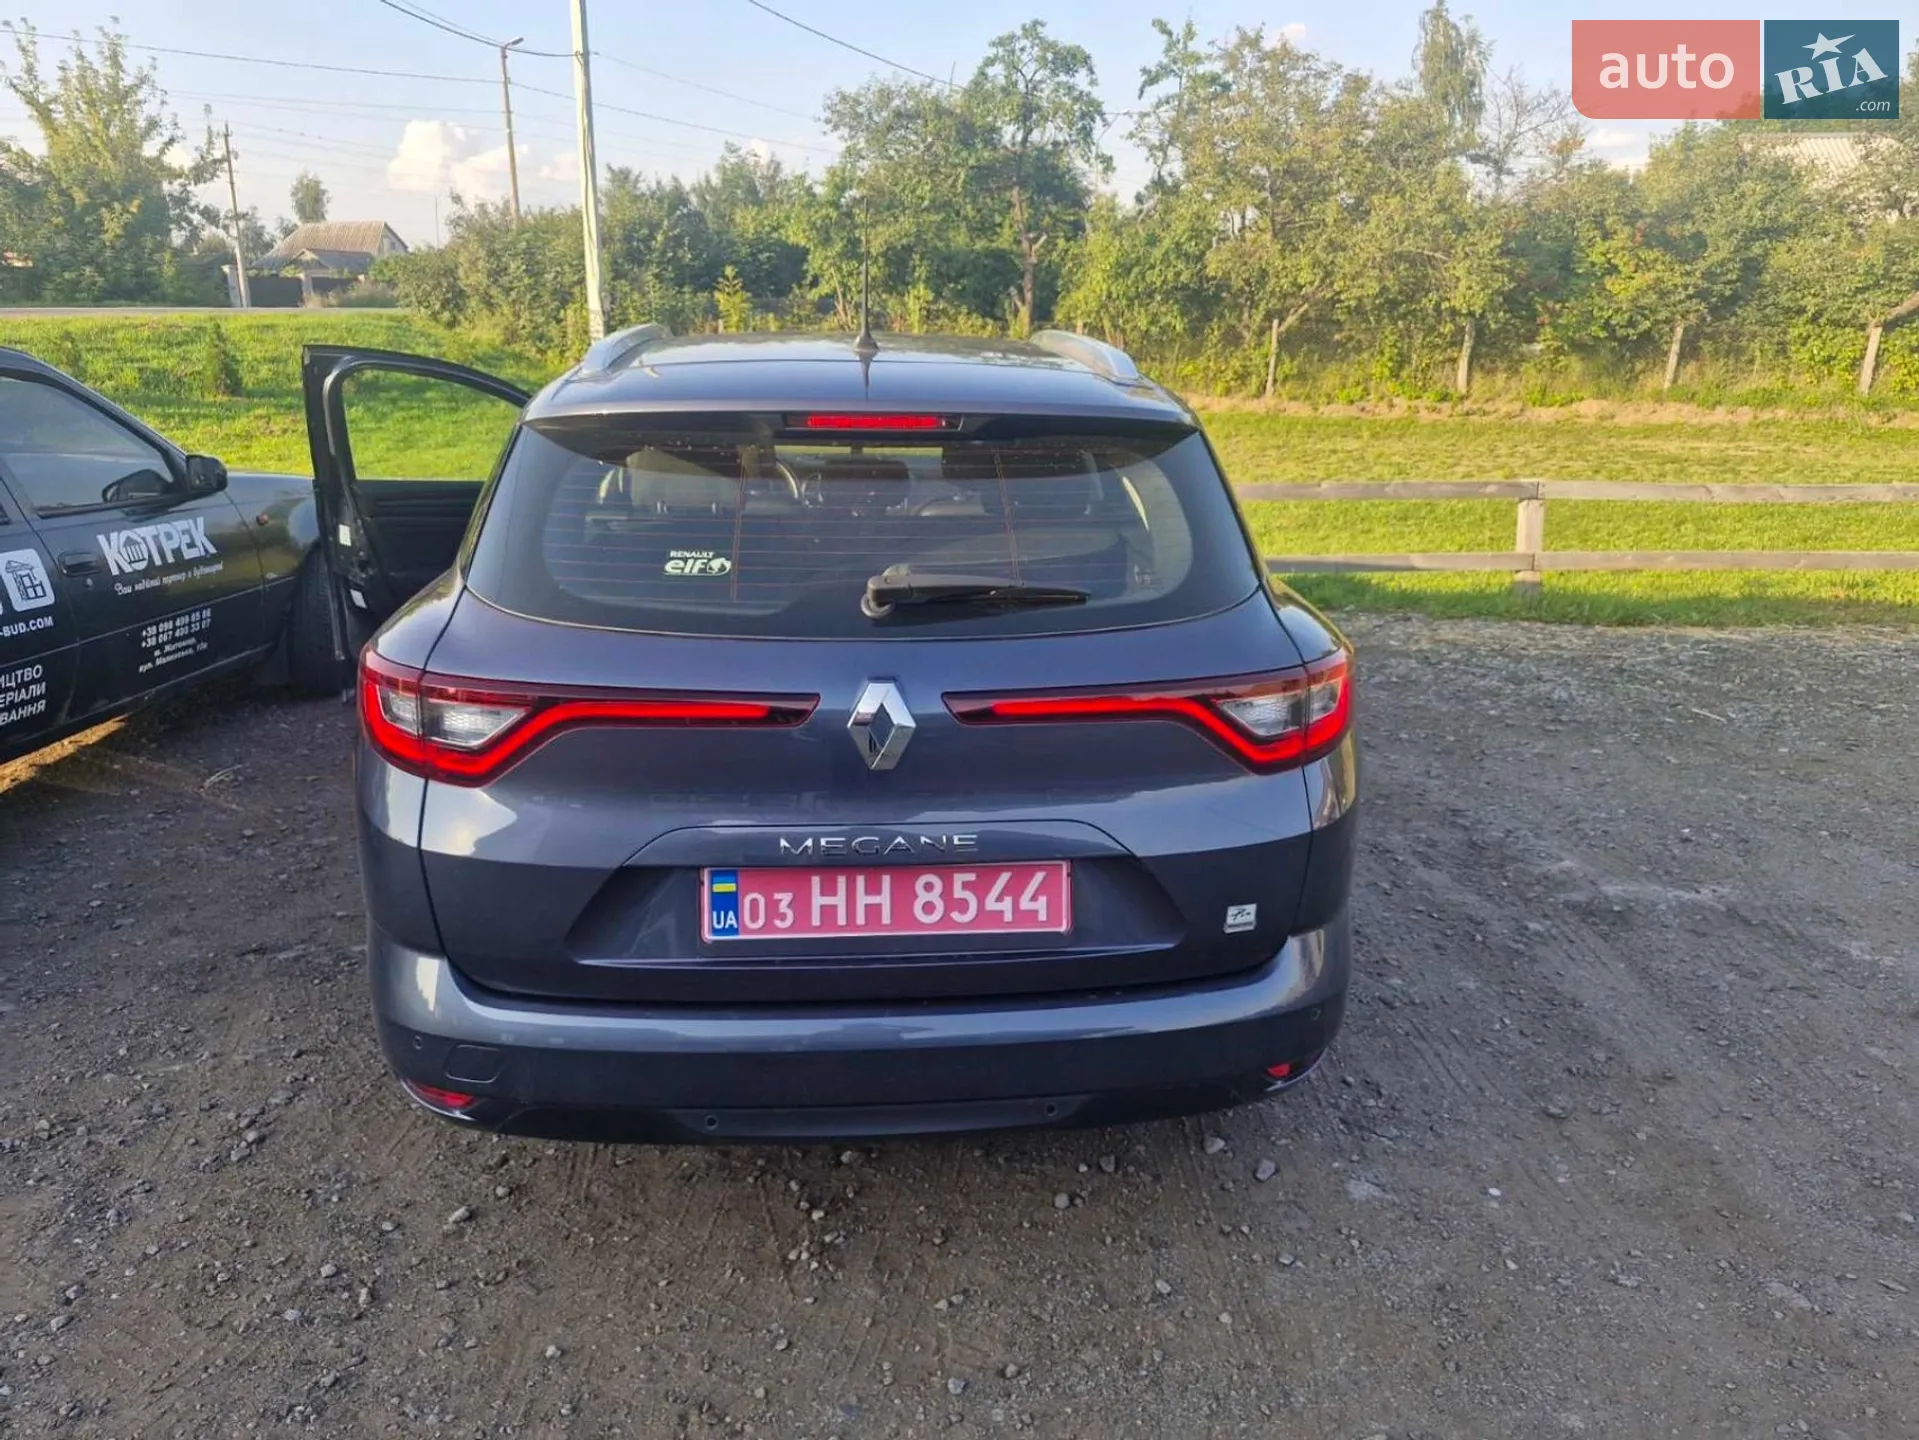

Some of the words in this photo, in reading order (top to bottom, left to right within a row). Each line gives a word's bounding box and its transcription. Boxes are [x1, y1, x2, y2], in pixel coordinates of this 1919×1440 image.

[96, 517, 217, 576] КОТРЕК
[669, 550, 715, 558] RENAULT
[664, 559, 708, 574] elf
[779, 834, 979, 857] MEGANE
[743, 892, 794, 930] 03
[810, 875, 892, 927] HH
[913, 871, 1048, 925] 8544
[712, 910, 738, 929] UA
